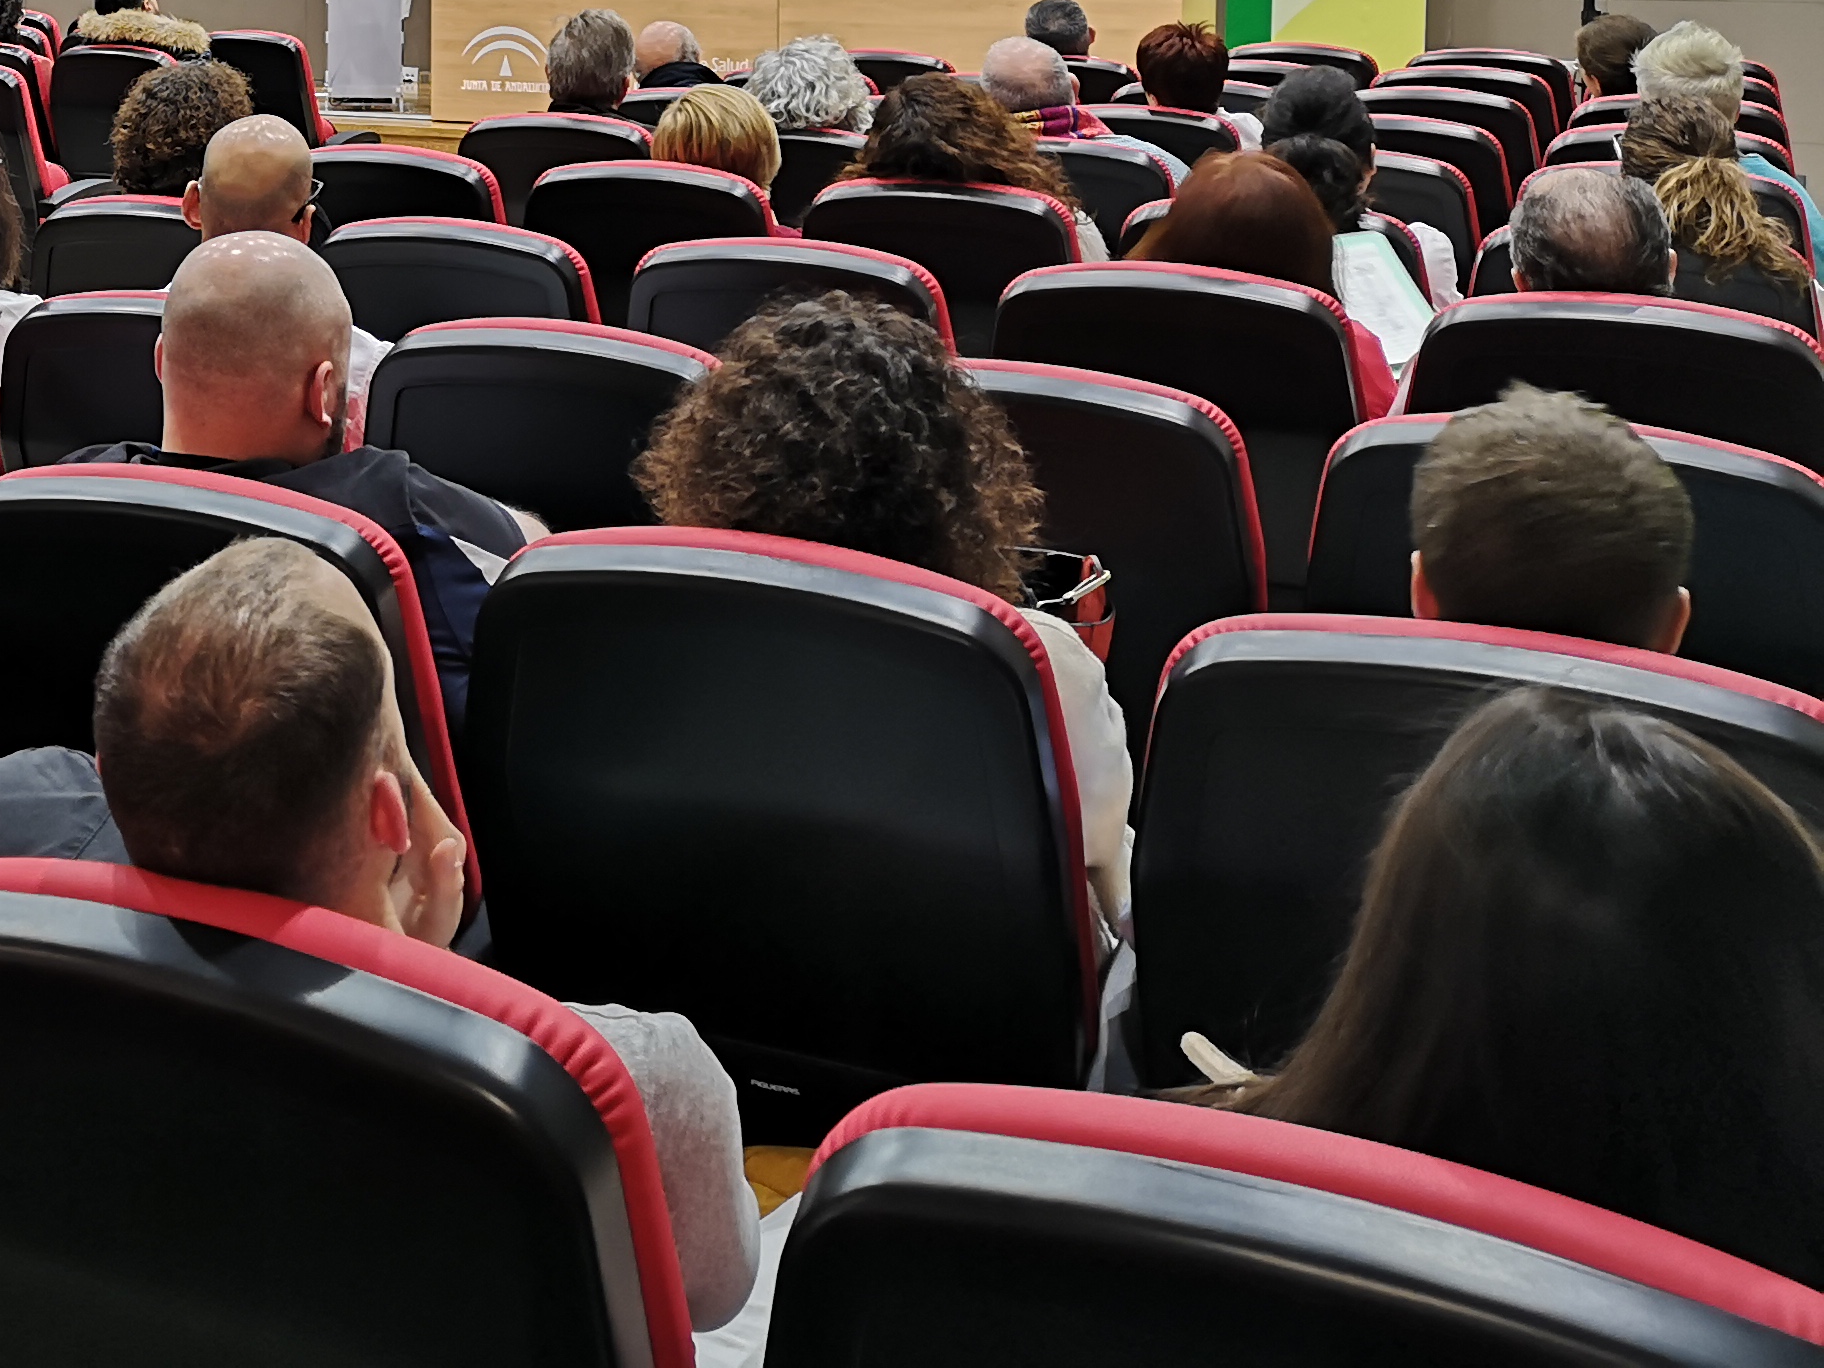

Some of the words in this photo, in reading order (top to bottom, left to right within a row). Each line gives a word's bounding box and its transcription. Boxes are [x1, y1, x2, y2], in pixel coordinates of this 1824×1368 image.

[711, 57, 749, 72] Salud
[460, 79, 488, 91] JUNTA
[490, 80, 502, 92] DE
